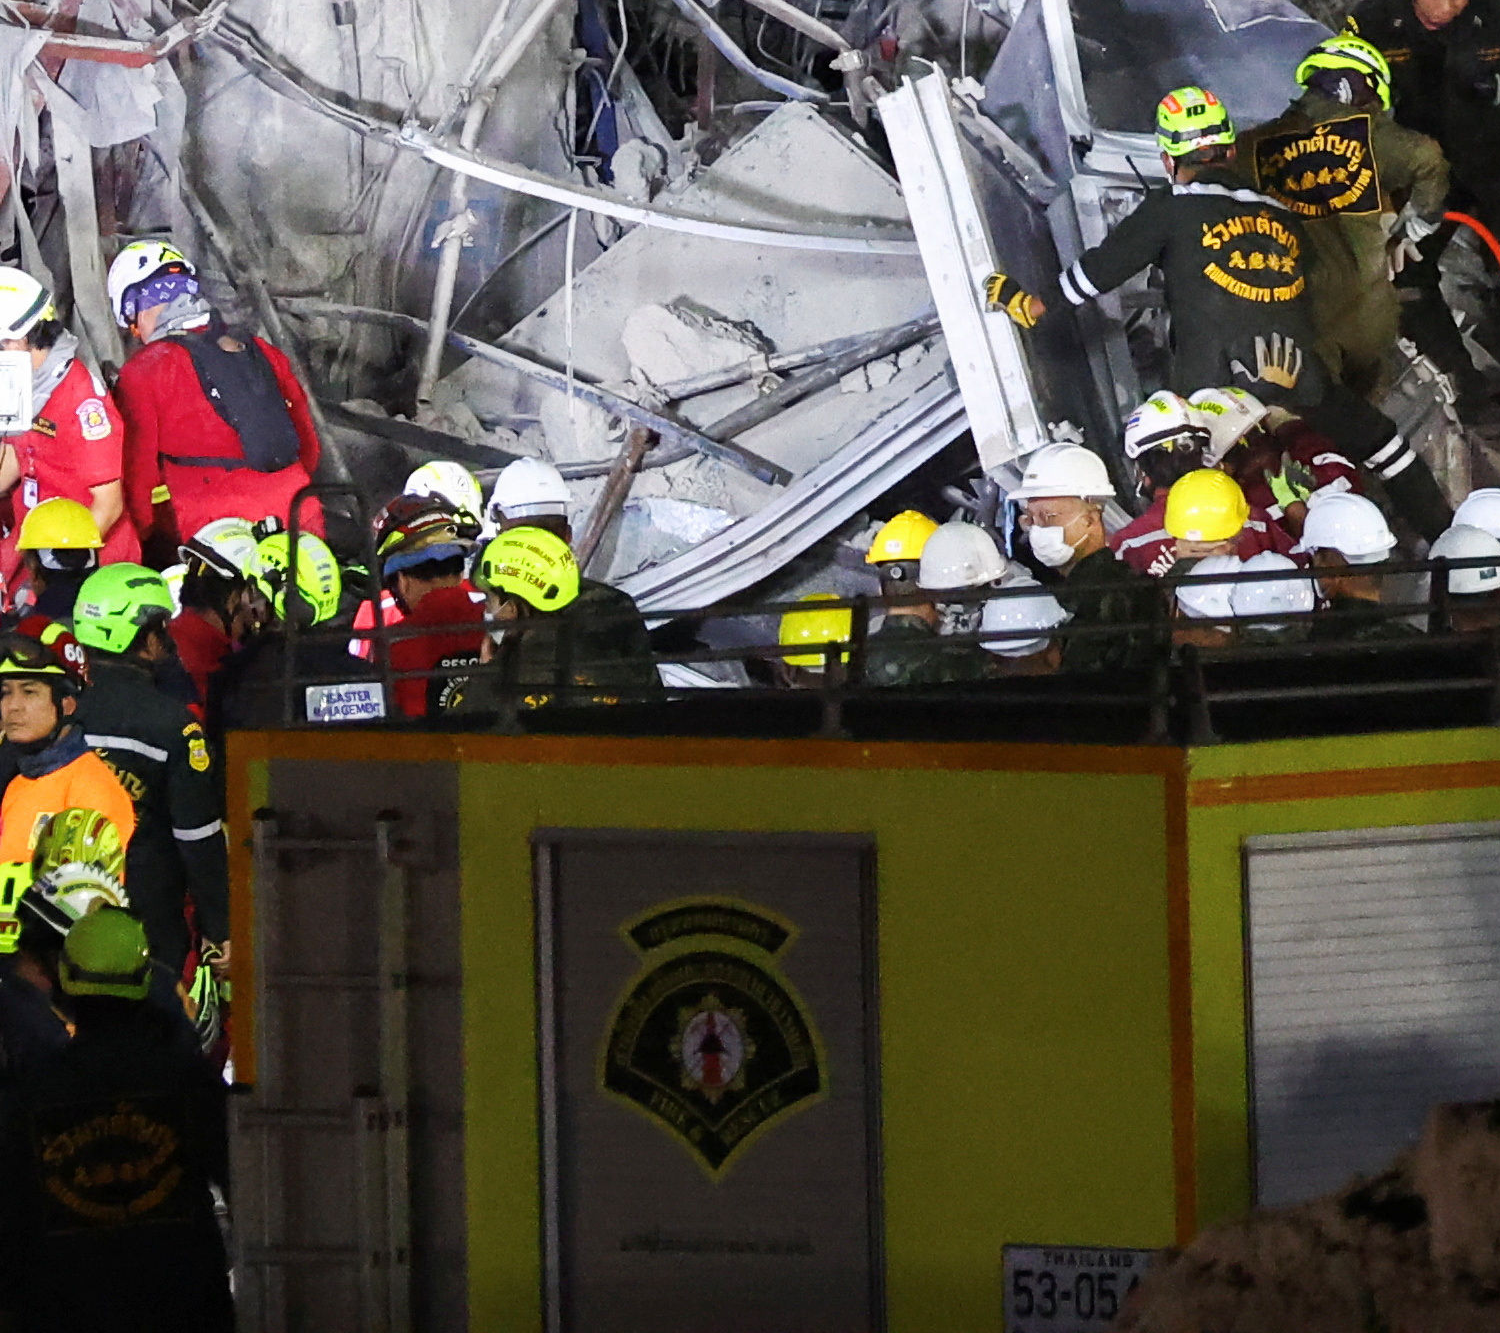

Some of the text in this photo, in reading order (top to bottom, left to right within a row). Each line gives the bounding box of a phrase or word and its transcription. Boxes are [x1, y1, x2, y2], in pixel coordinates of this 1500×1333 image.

[523, 571, 547, 591] TEAM
[64, 643, 85, 664] 60
[1043, 1251, 1134, 1268] THAILAND
